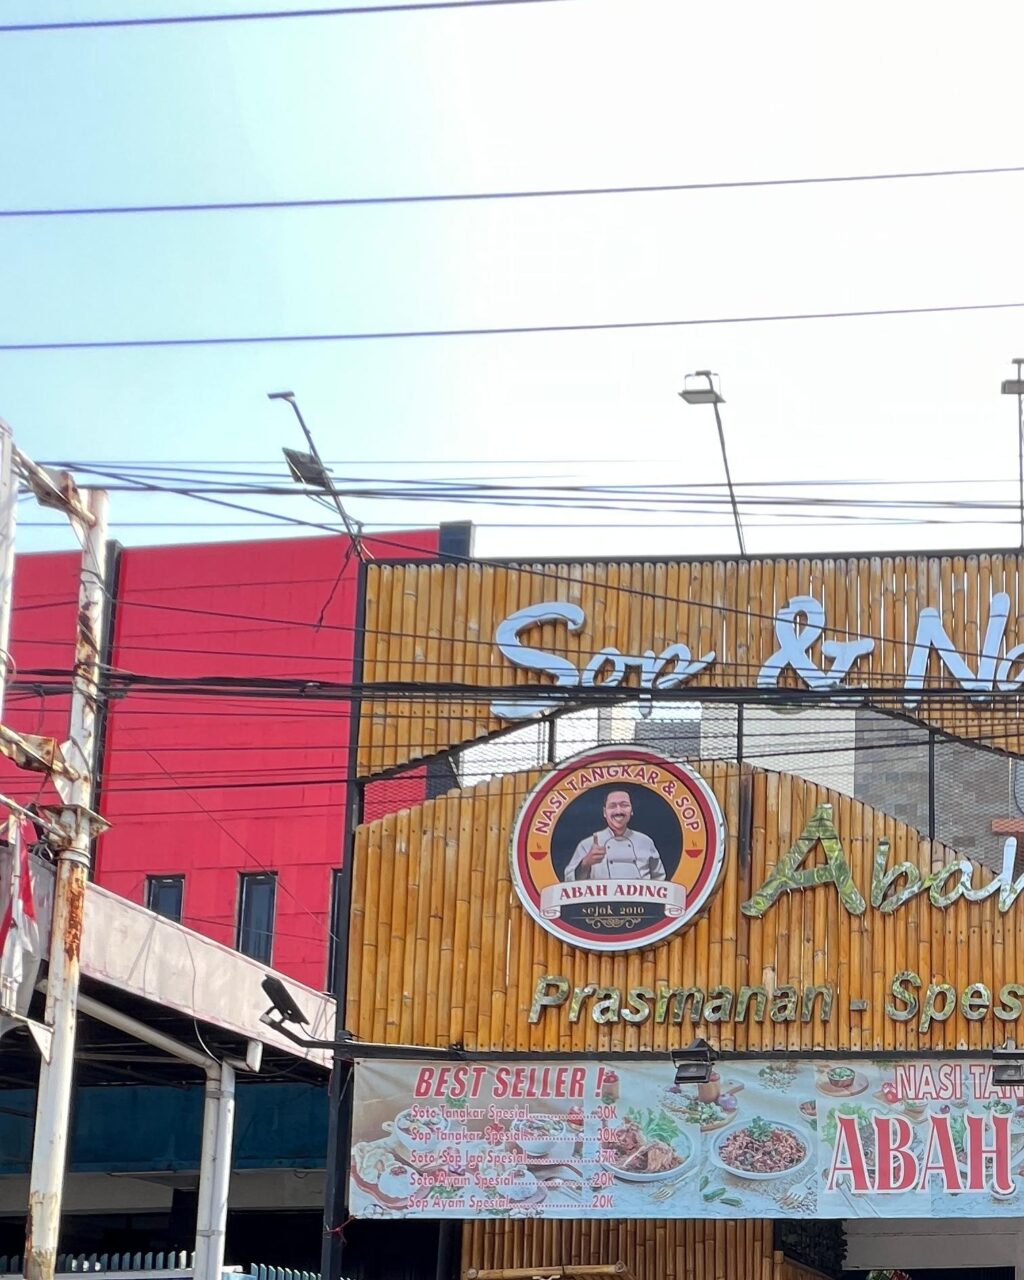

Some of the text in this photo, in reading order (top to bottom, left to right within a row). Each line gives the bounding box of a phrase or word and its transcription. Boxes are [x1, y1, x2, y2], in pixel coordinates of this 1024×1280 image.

[495, 600, 717, 719] Sop
[755, 595, 875, 691] &
[535, 765, 701, 834] NASI TANGKAR & SOP
[559, 884, 668, 901] ABAH ADING
[619, 906, 645, 915] 2010
[527, 974, 834, 1025] Prasmanan
[413, 1066, 605, 1099] BEST SELLER !
[894, 1064, 962, 1099] NASI
[411, 1104, 618, 1123] Soto Tangkar Spesial 30K
[411, 1126, 619, 1146] Sop Tangkar Spesial 30K
[465, 1149, 483, 1169] Iga
[487, 1149, 528, 1168] Spesial
[826, 1109, 1017, 1194] ABAH
[409, 1171, 615, 1191] Soto Ayam Spesial 20K
[407, 1194, 614, 1212] Sop Ayam Spesial 20K
